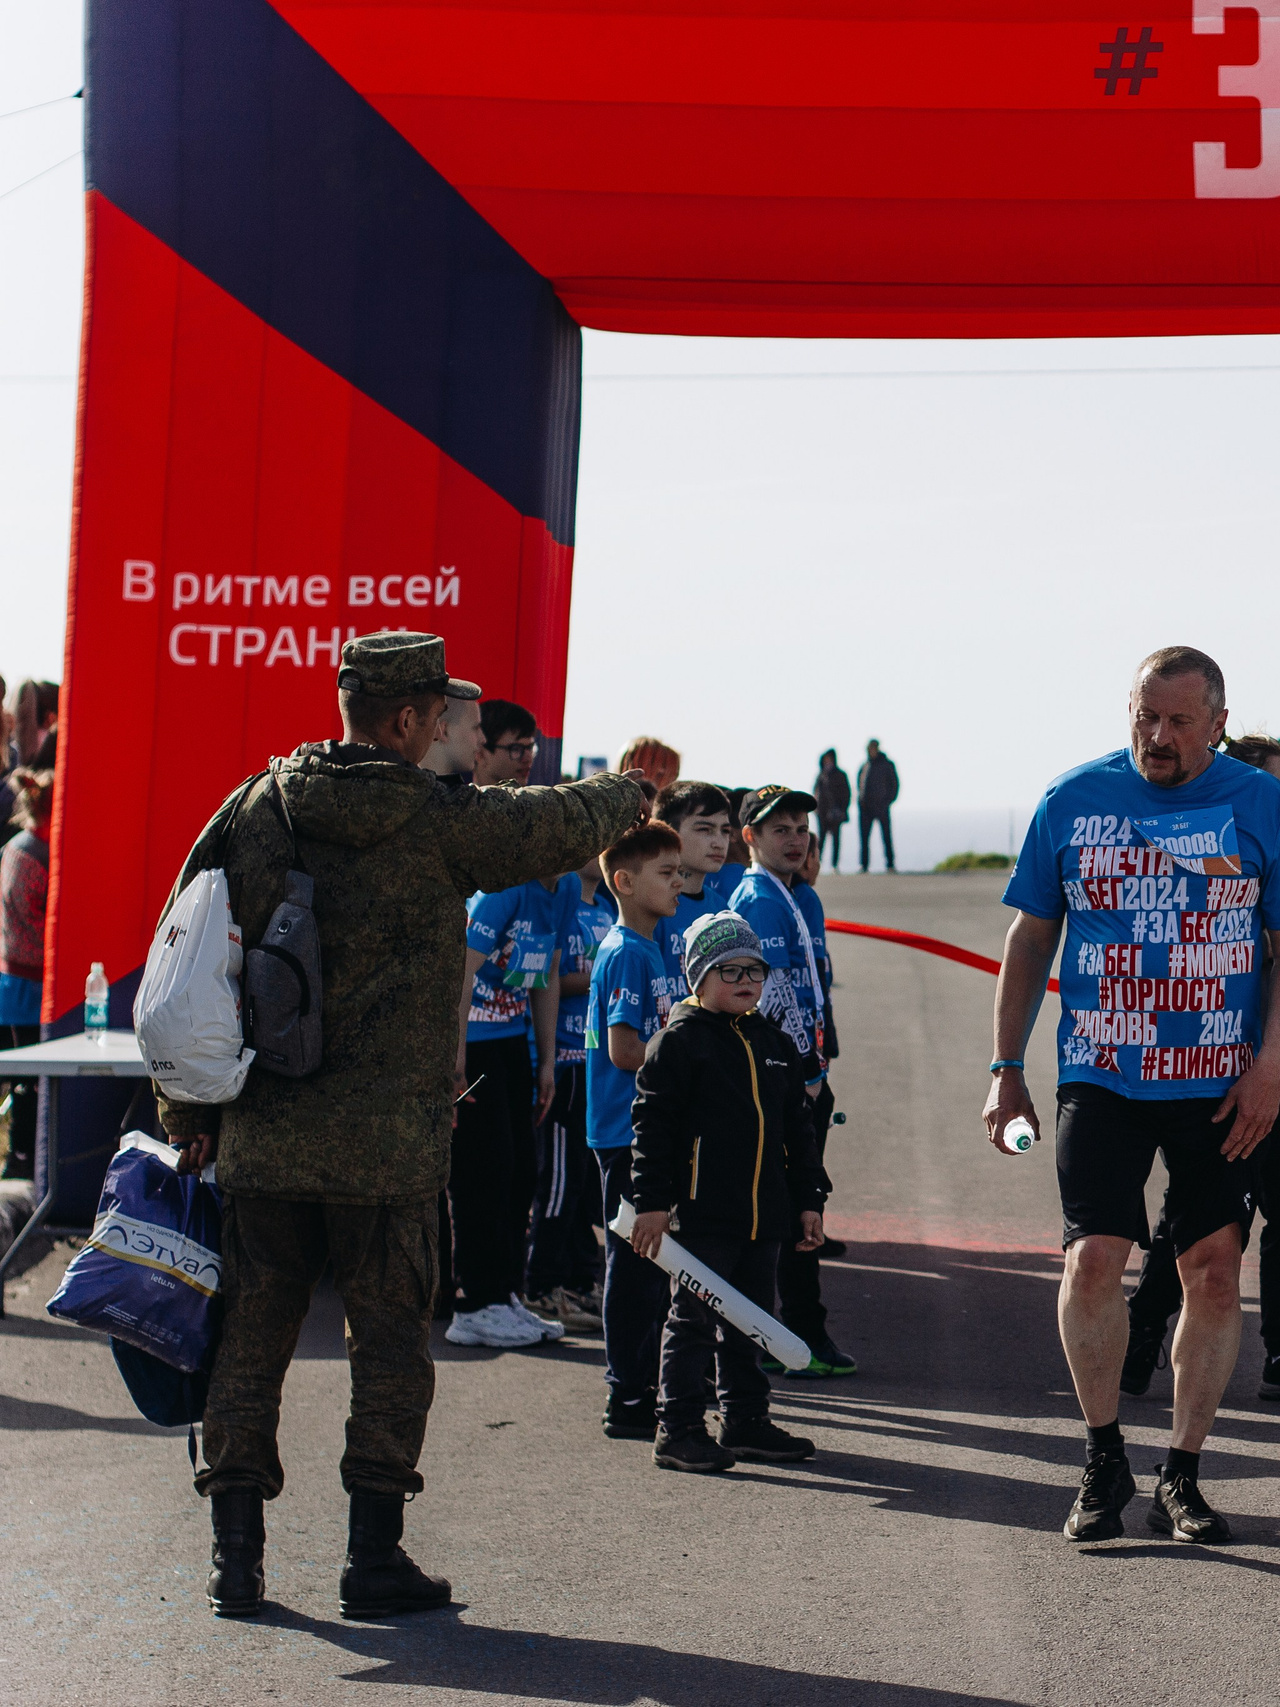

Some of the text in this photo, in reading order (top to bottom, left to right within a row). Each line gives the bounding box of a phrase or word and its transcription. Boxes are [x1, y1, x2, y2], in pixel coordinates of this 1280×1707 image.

[122, 560, 461, 612] В ритме всей
[168, 622, 408, 668] СТРАН
[1069, 815, 1133, 847] 2024
[1153, 831, 1218, 857] 20008
[1079, 846, 1174, 879] #МЕЧТА
[1062, 876, 1261, 911] #ЗАБЕГ2024 #ЦЕЛЬ
[472, 921, 496, 939] ПСБ
[760, 936, 785, 949] ПСБ
[1131, 909, 1255, 944] #ЗАБЕГ2024
[1077, 939, 1255, 978] #ЗАБЕГ #МОМЕНТ
[1098, 977, 1226, 1013] #ГОРДОСТЬ
[1197, 1009, 1243, 1046] 2024
[158, 1060, 176, 1071] ПСБ
[1139, 1041, 1256, 1081] #ЕДИНСТВО
[150, 1272, 176, 1290] letu.ru
